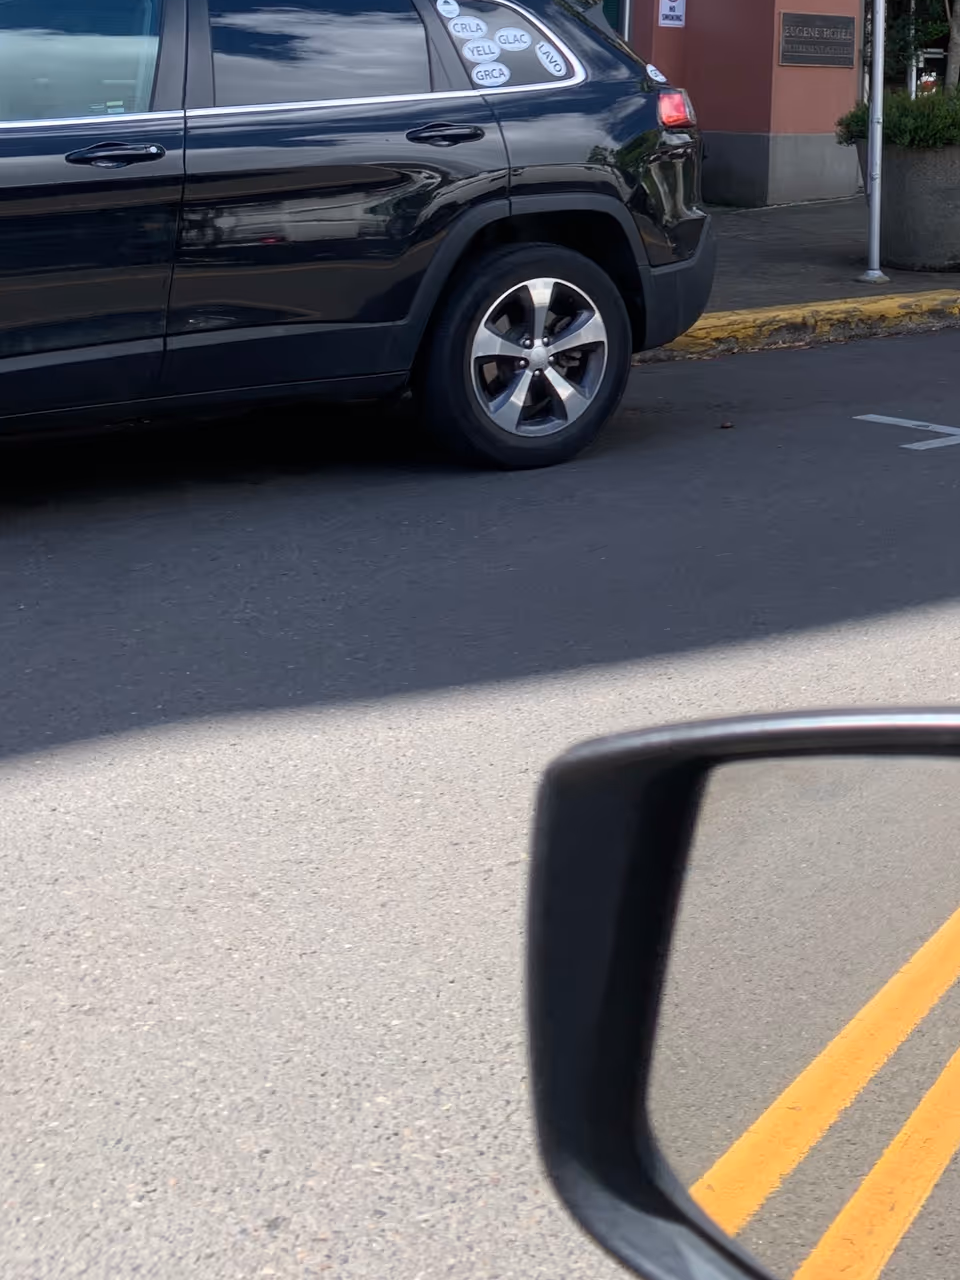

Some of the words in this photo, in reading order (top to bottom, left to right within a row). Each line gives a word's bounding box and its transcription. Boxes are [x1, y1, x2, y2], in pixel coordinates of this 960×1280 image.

[668, 5, 676, 13] NO
[661, 13, 683, 22] SMOKING
[452, 22, 484, 34] CRLA
[784, 26, 820, 38] EUGENE
[823, 28, 852, 39] HOTEL
[498, 33, 528, 45] GLAC
[467, 45, 496, 57] YELL
[538, 43, 563, 73] LAVO
[475, 68, 506, 81] GRCA
